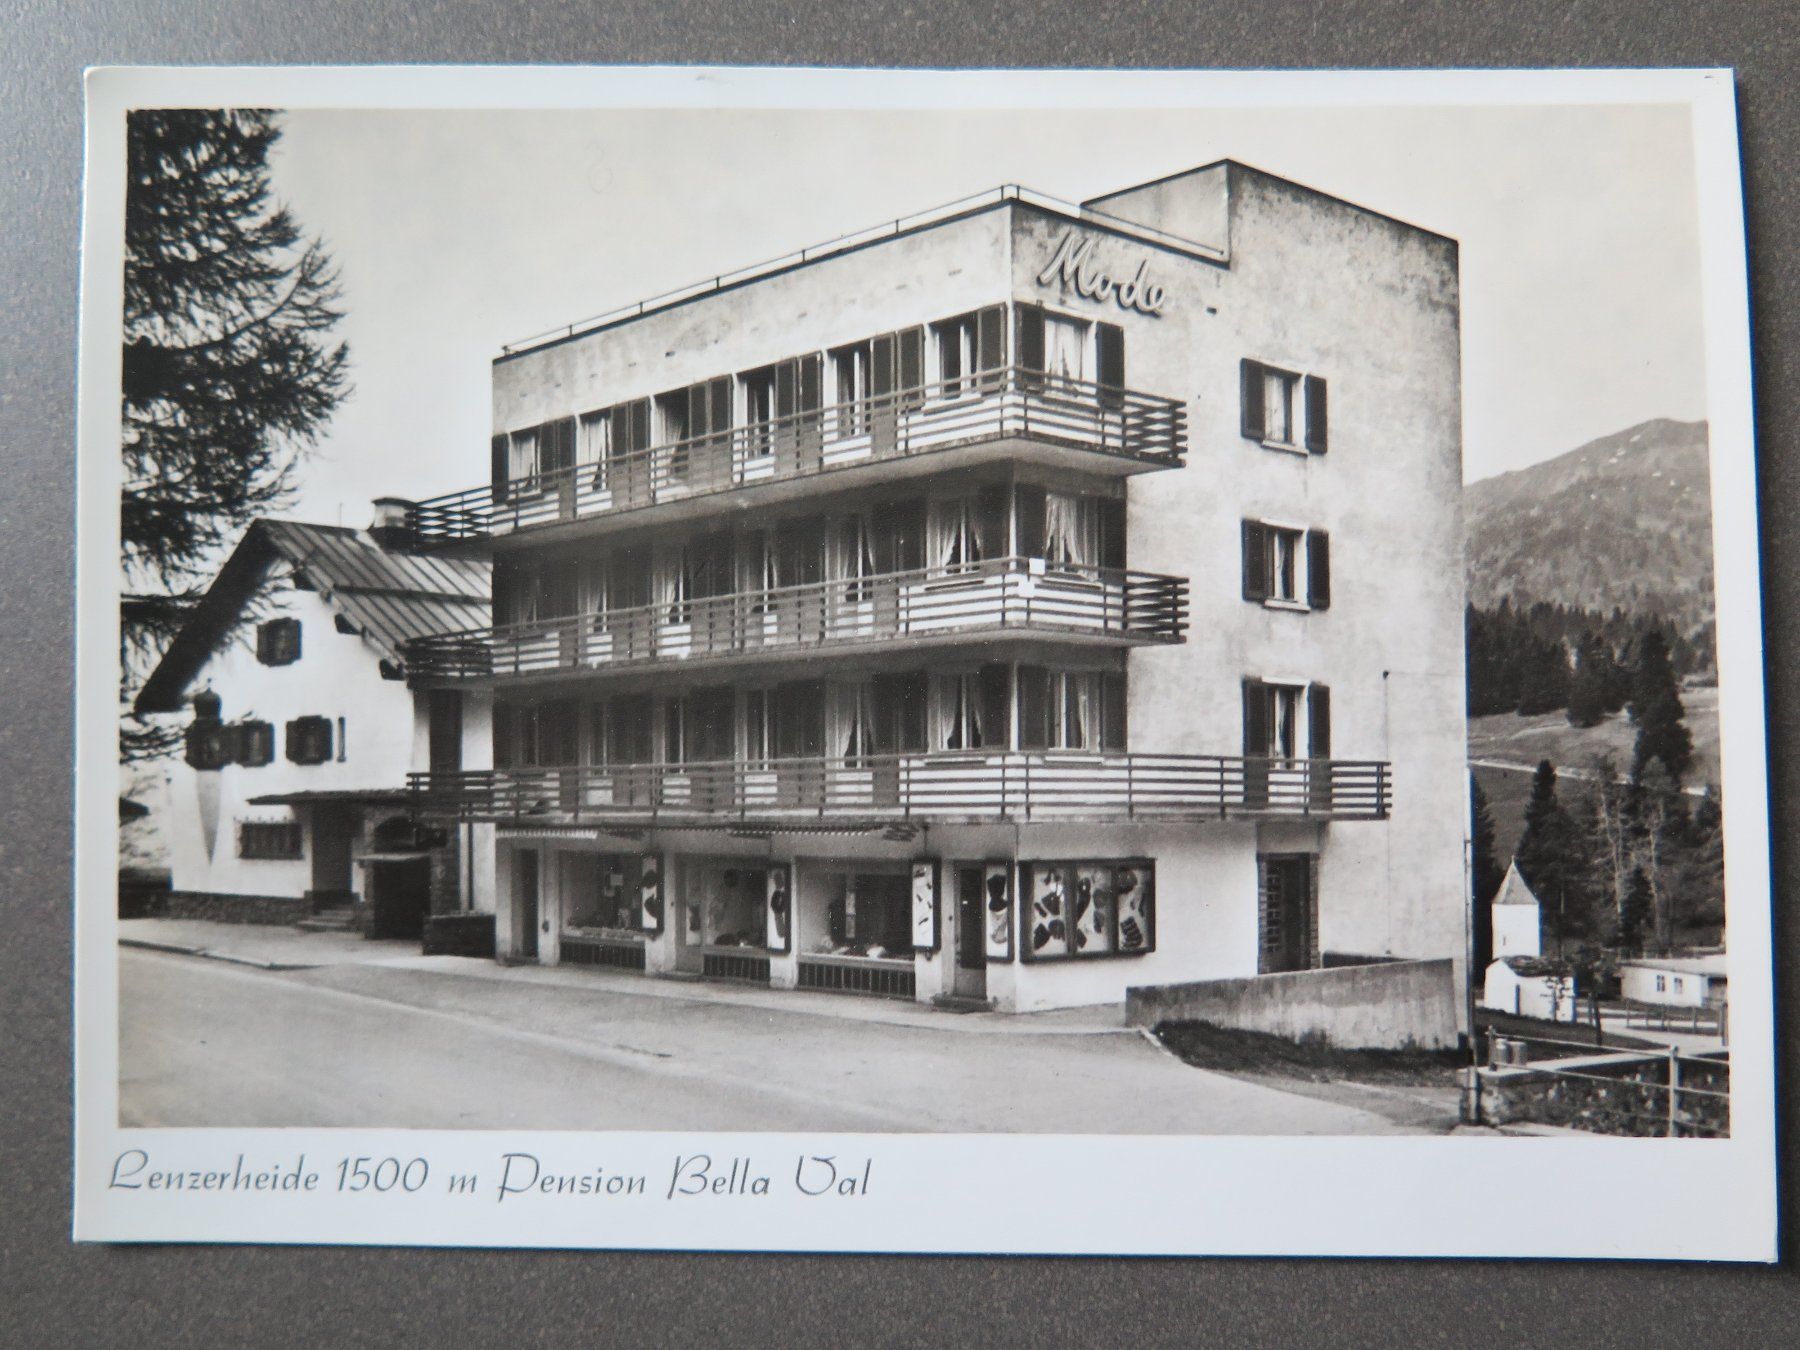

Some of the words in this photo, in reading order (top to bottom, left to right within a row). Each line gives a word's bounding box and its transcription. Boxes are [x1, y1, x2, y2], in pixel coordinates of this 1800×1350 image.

[1036, 230, 1166, 317] Mode
[109, 1149, 319, 1192] Lenzerheide
[336, 1156, 430, 1193] 1500
[448, 1174, 478, 1194] m
[498, 1152, 646, 1203] Pension
[667, 1153, 771, 1200] Bella
[795, 1154, 872, 1196] Val
